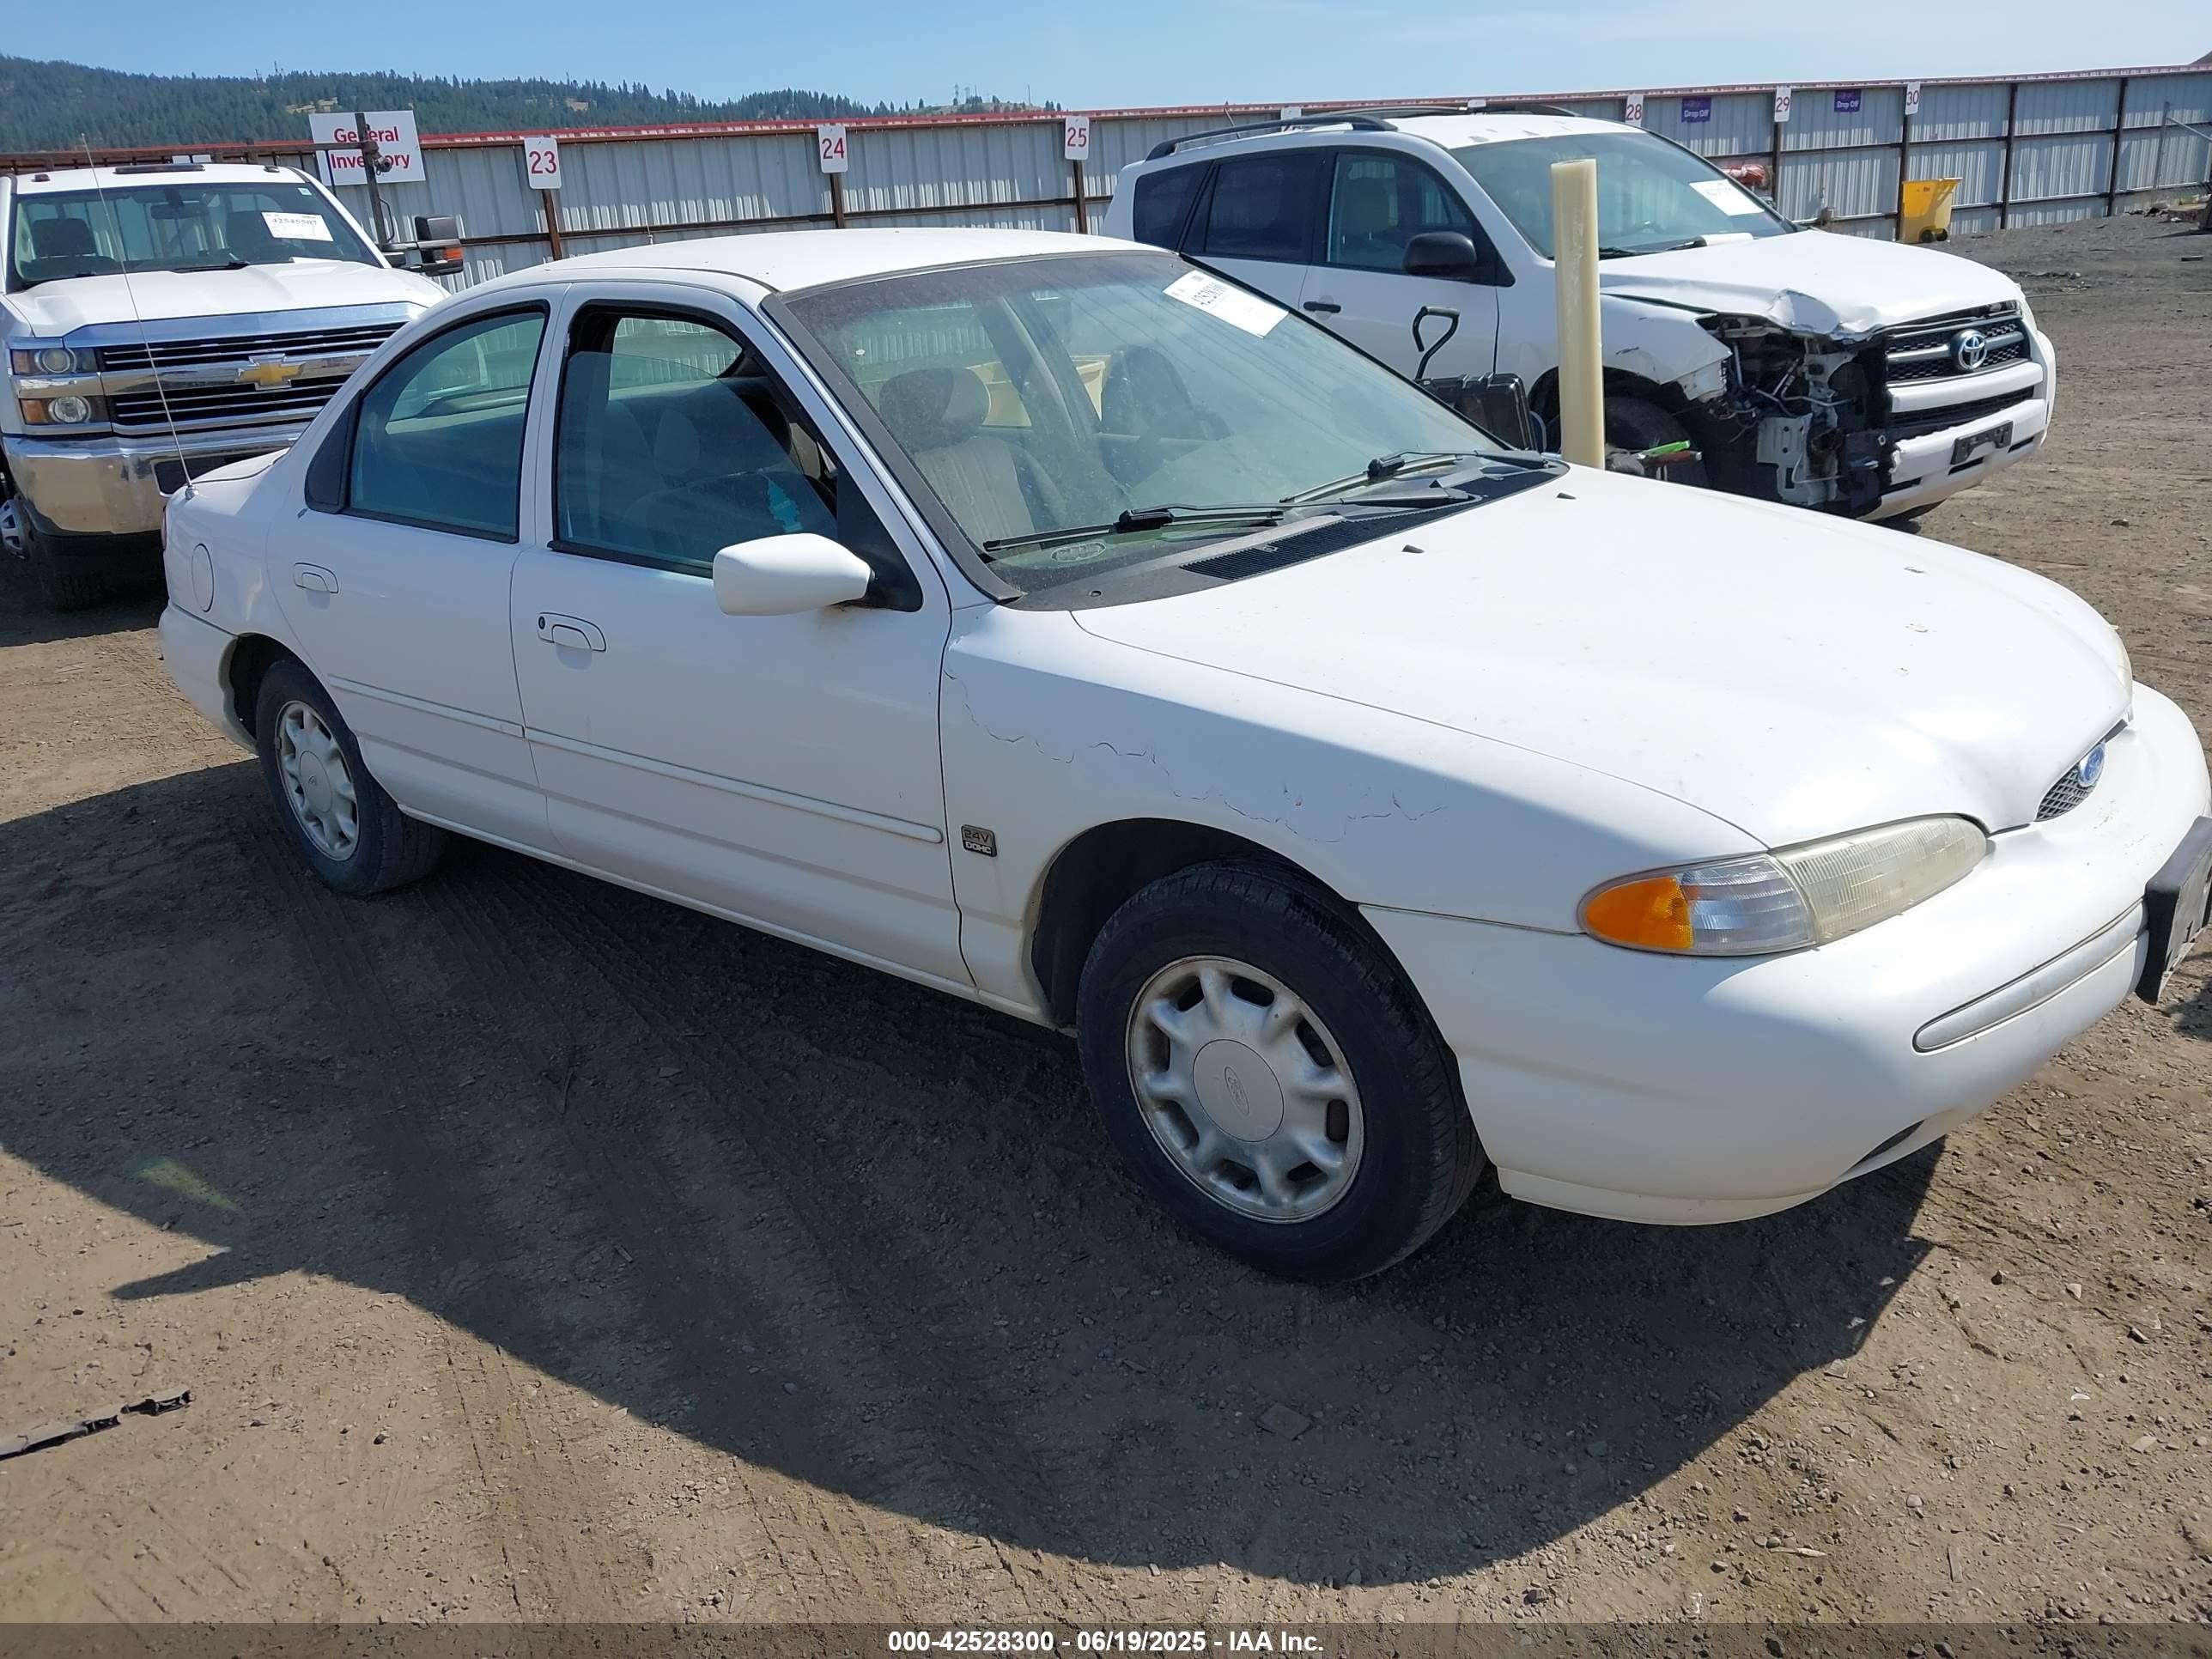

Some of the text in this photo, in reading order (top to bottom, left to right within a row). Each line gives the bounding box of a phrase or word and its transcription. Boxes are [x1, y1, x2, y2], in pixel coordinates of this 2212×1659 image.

[1776, 97, 1790, 112] 29
[1906, 90, 1919, 106] 30
[1626, 104, 1642, 120] 28
[334, 126, 399, 143] Geeral
[1067, 127, 1087, 148] 25
[822, 137, 844, 159] 24
[529, 150, 557, 173] 23
[963, 829, 990, 842] 24V
[965, 842, 992, 854] DOHC
